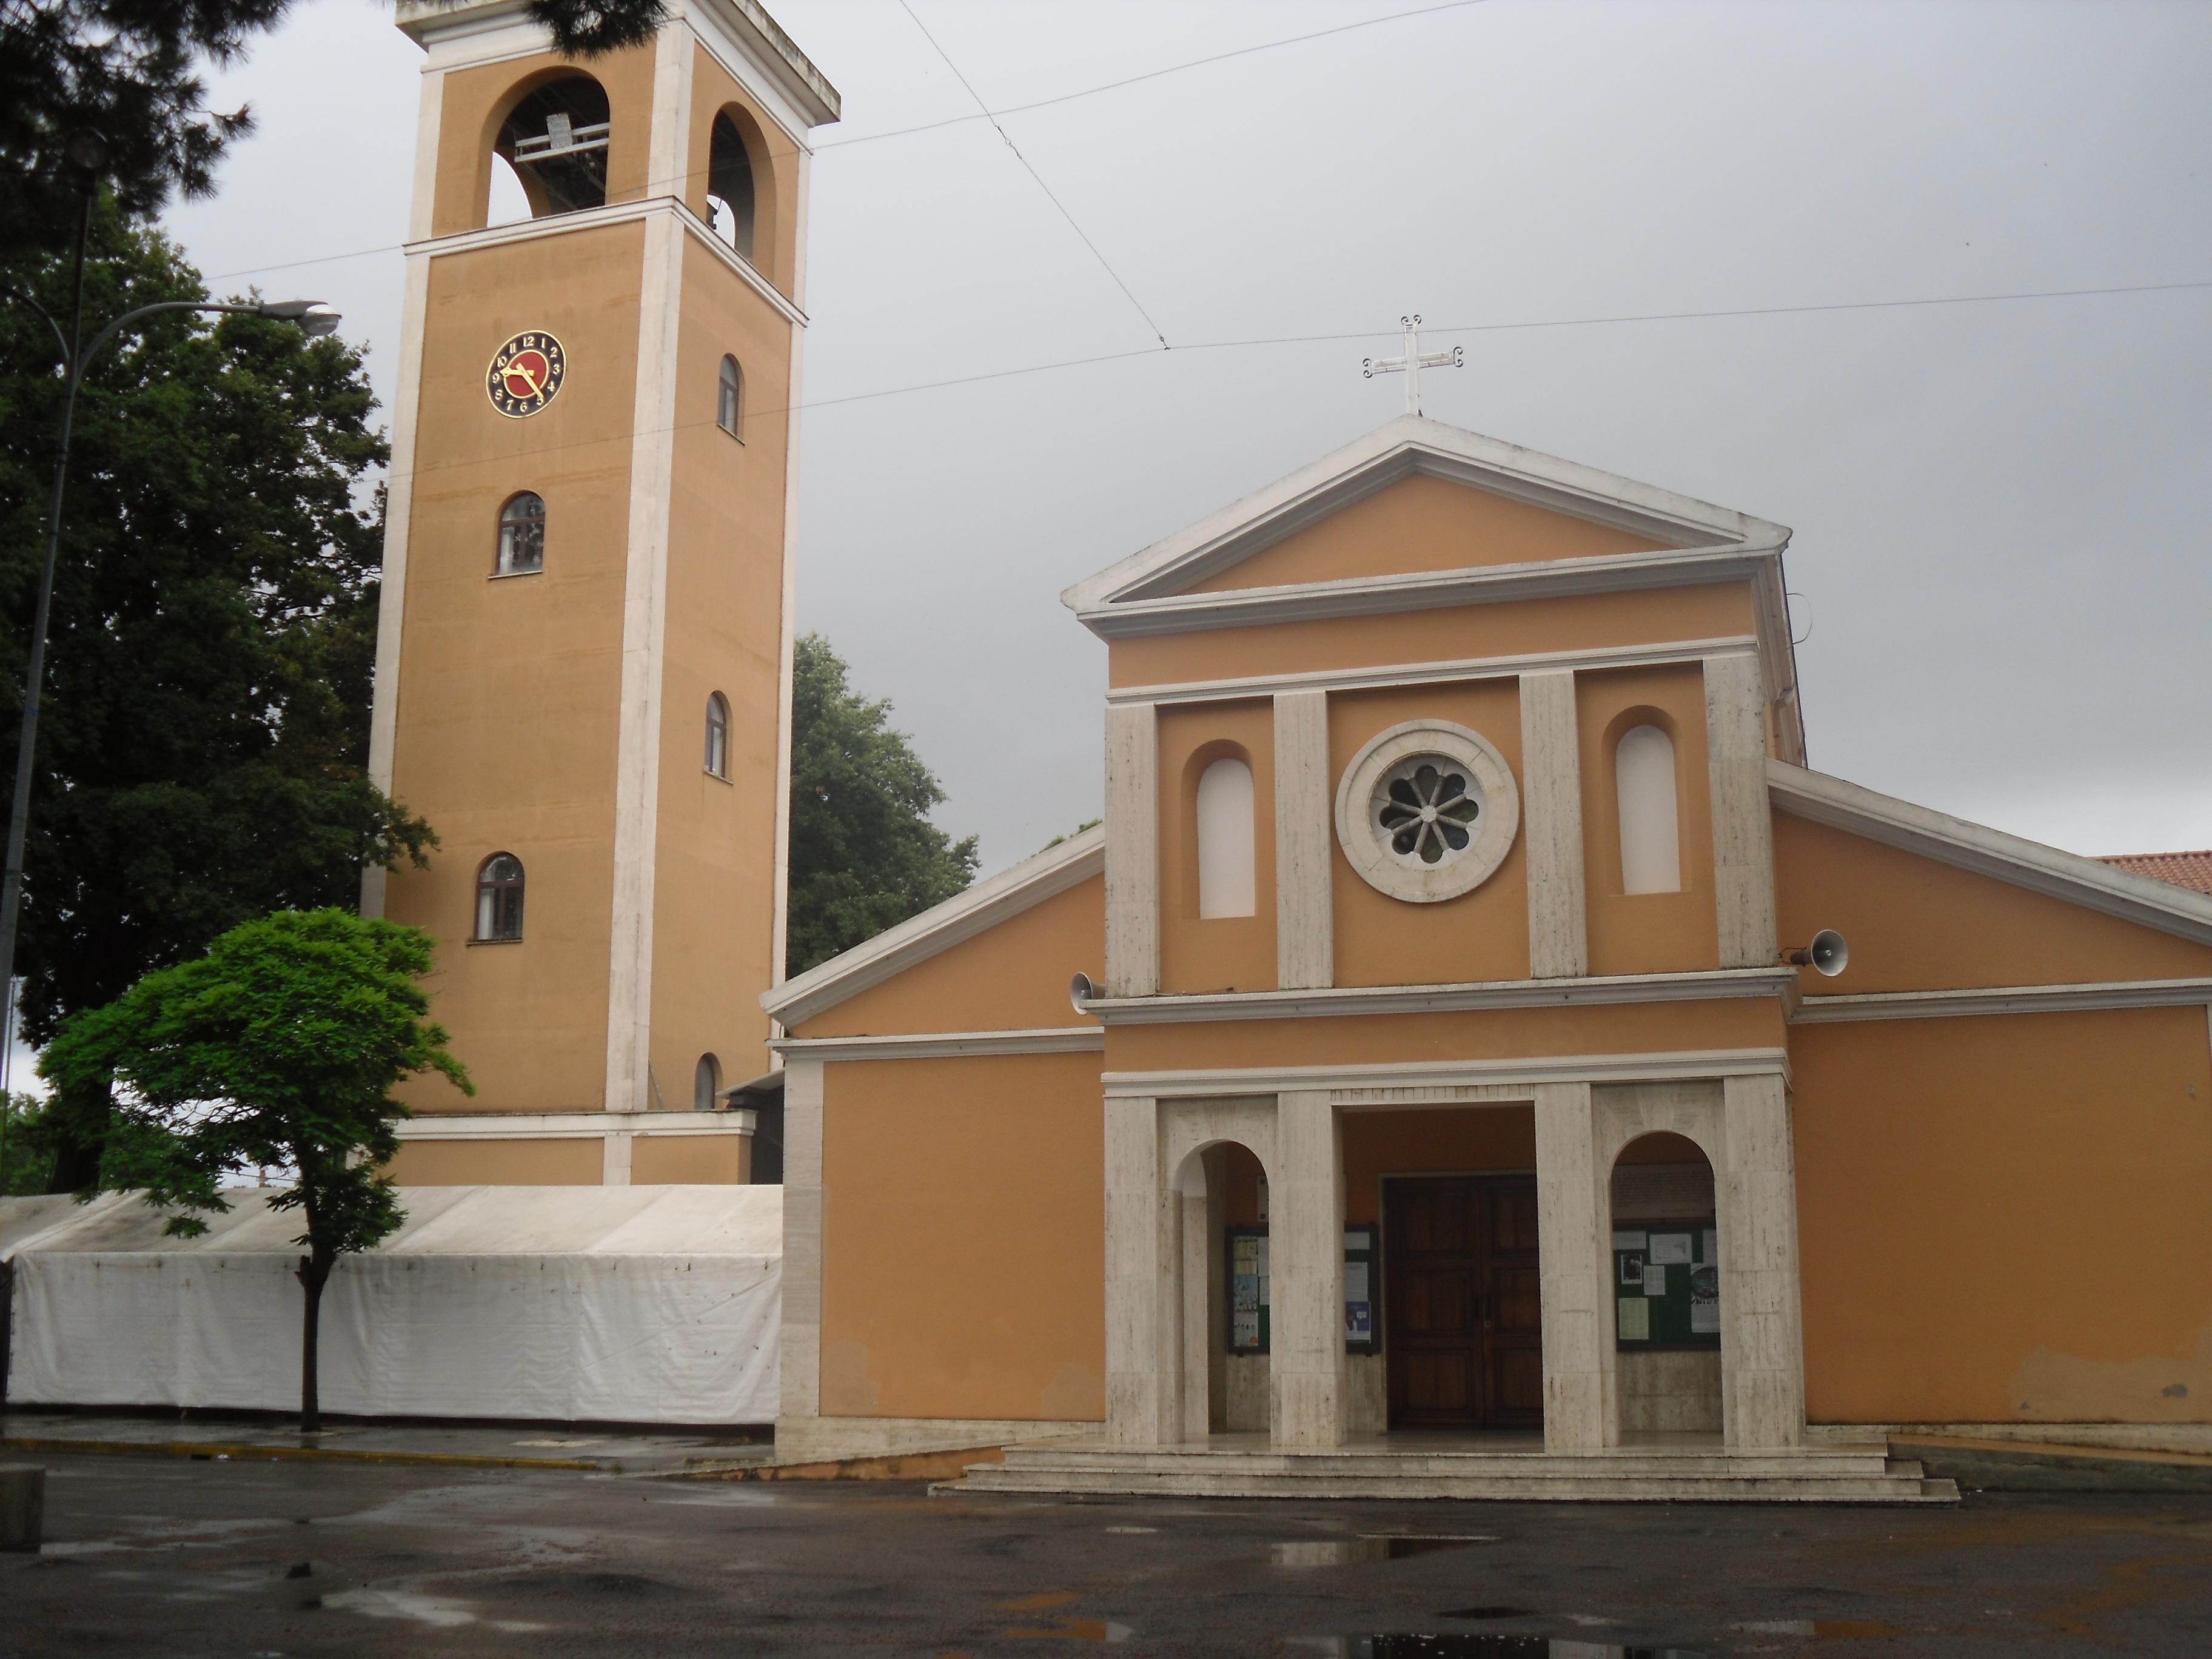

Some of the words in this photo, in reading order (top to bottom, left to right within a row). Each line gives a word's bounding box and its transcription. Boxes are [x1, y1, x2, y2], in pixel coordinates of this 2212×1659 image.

[523, 336, 534, 347] 12
[541, 338, 546, 348] 1
[509, 343, 517, 354] 11
[551, 347, 558, 358] 2
[497, 356, 508, 367] 10
[553, 364, 561, 374] 3
[492, 373, 500, 383] 9
[548, 381, 555, 392] 4
[495, 389, 503, 400] 8
[506, 400, 514, 411] 7
[520, 402, 528, 412] 6
